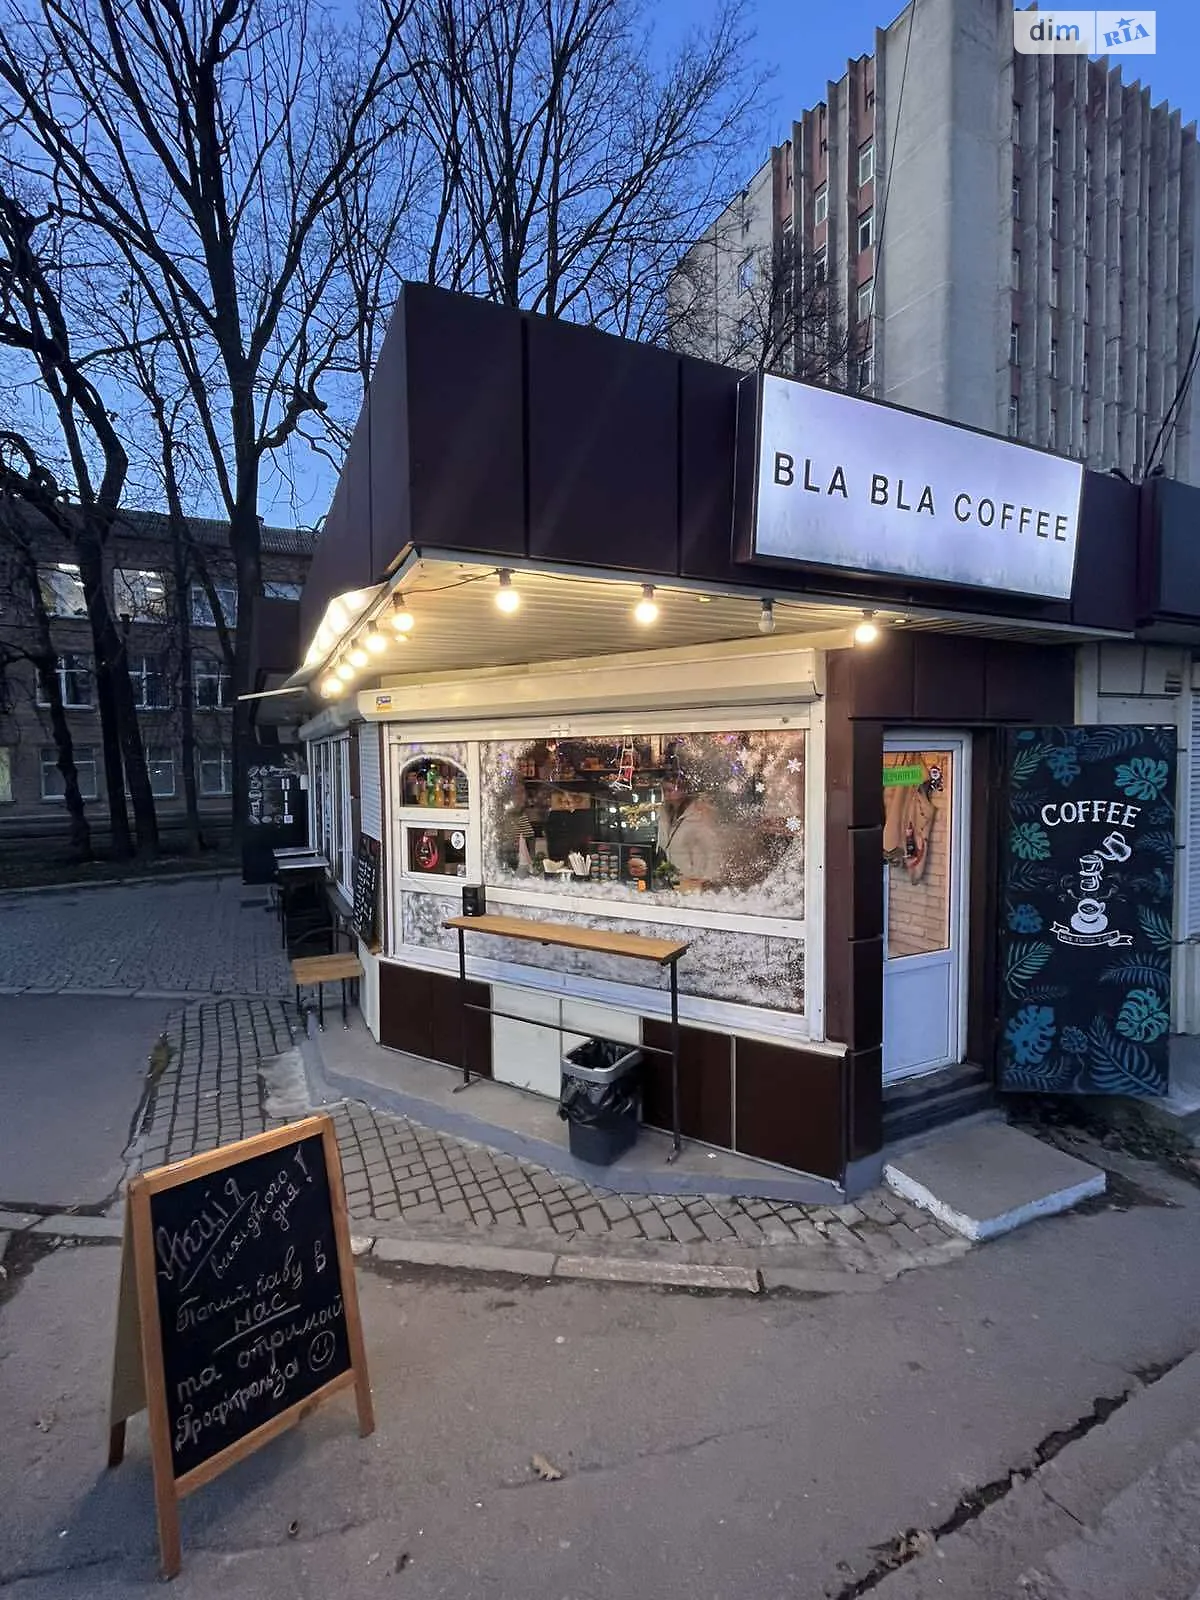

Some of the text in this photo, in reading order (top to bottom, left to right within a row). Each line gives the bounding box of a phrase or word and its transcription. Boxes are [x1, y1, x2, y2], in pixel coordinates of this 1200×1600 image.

[773, 451, 1069, 542] BLA BLA COFFEE
[1040, 799, 1142, 828] COFFEE
[176, 1295, 344, 1405] та отримай
